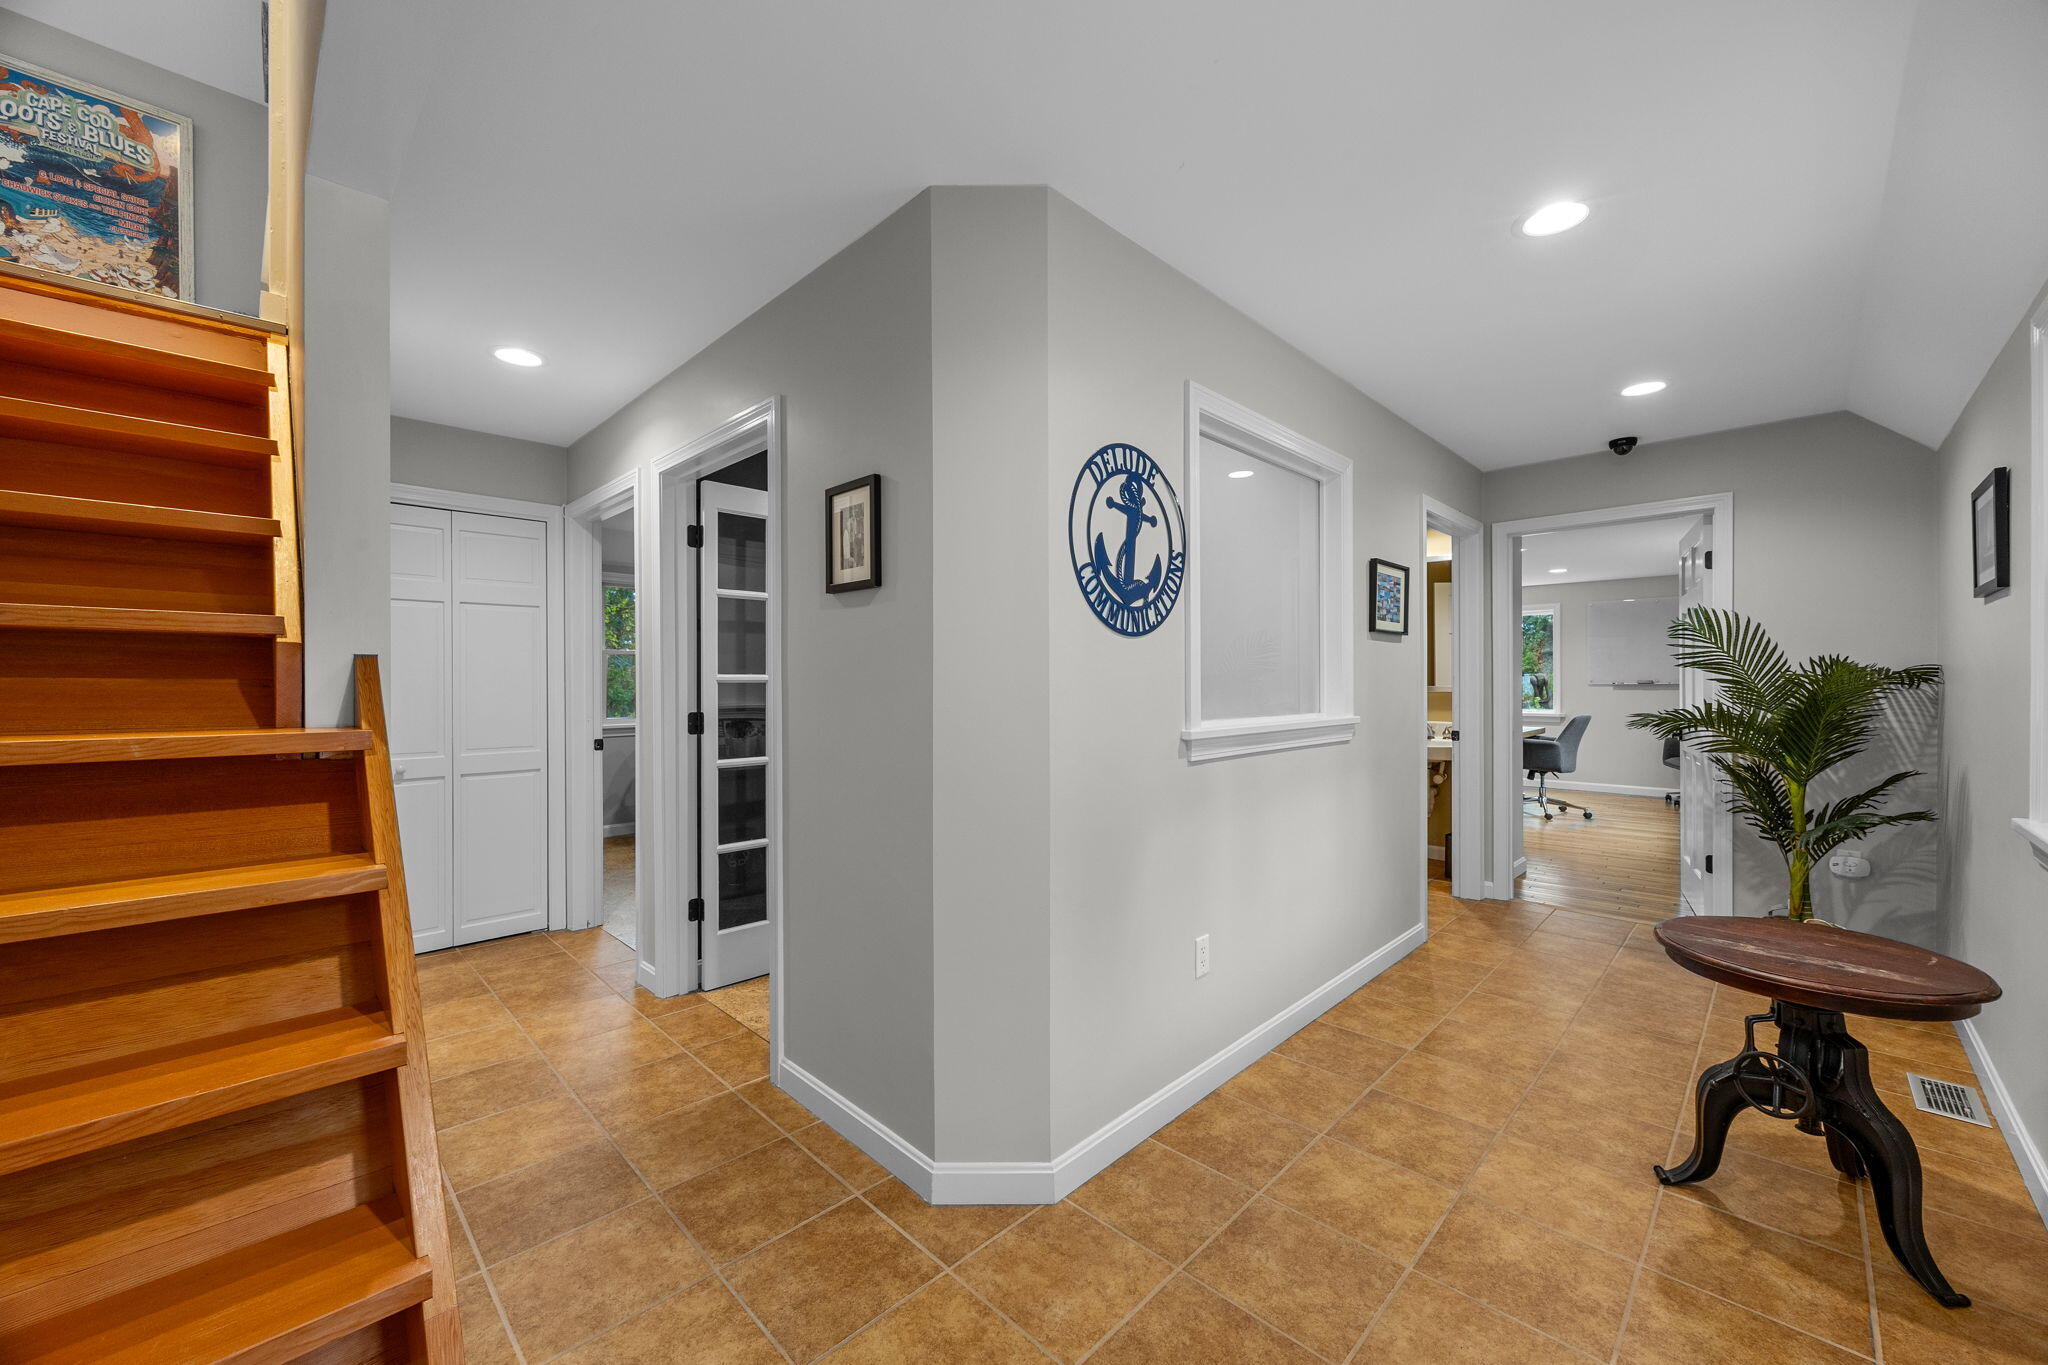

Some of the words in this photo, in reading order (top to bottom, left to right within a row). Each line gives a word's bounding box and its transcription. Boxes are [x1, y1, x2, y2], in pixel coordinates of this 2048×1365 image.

[26, 92, 71, 117] CAPE
[77, 105, 112, 130] COD
[0, 98, 61, 130] OOTS
[68, 122, 77, 133] &
[83, 124, 151, 165] BLUES
[42, 129, 102, 157] FESTIVAL
[2, 178, 52, 199] CHADWICK
[53, 191, 88, 208] STOKES
[49, 172, 73, 186] LOVE
[83, 182, 119, 198] SPECIAL
[1087, 448, 1159, 487] DELUDE
[1078, 550, 1184, 632] COMMUNICATIONS
